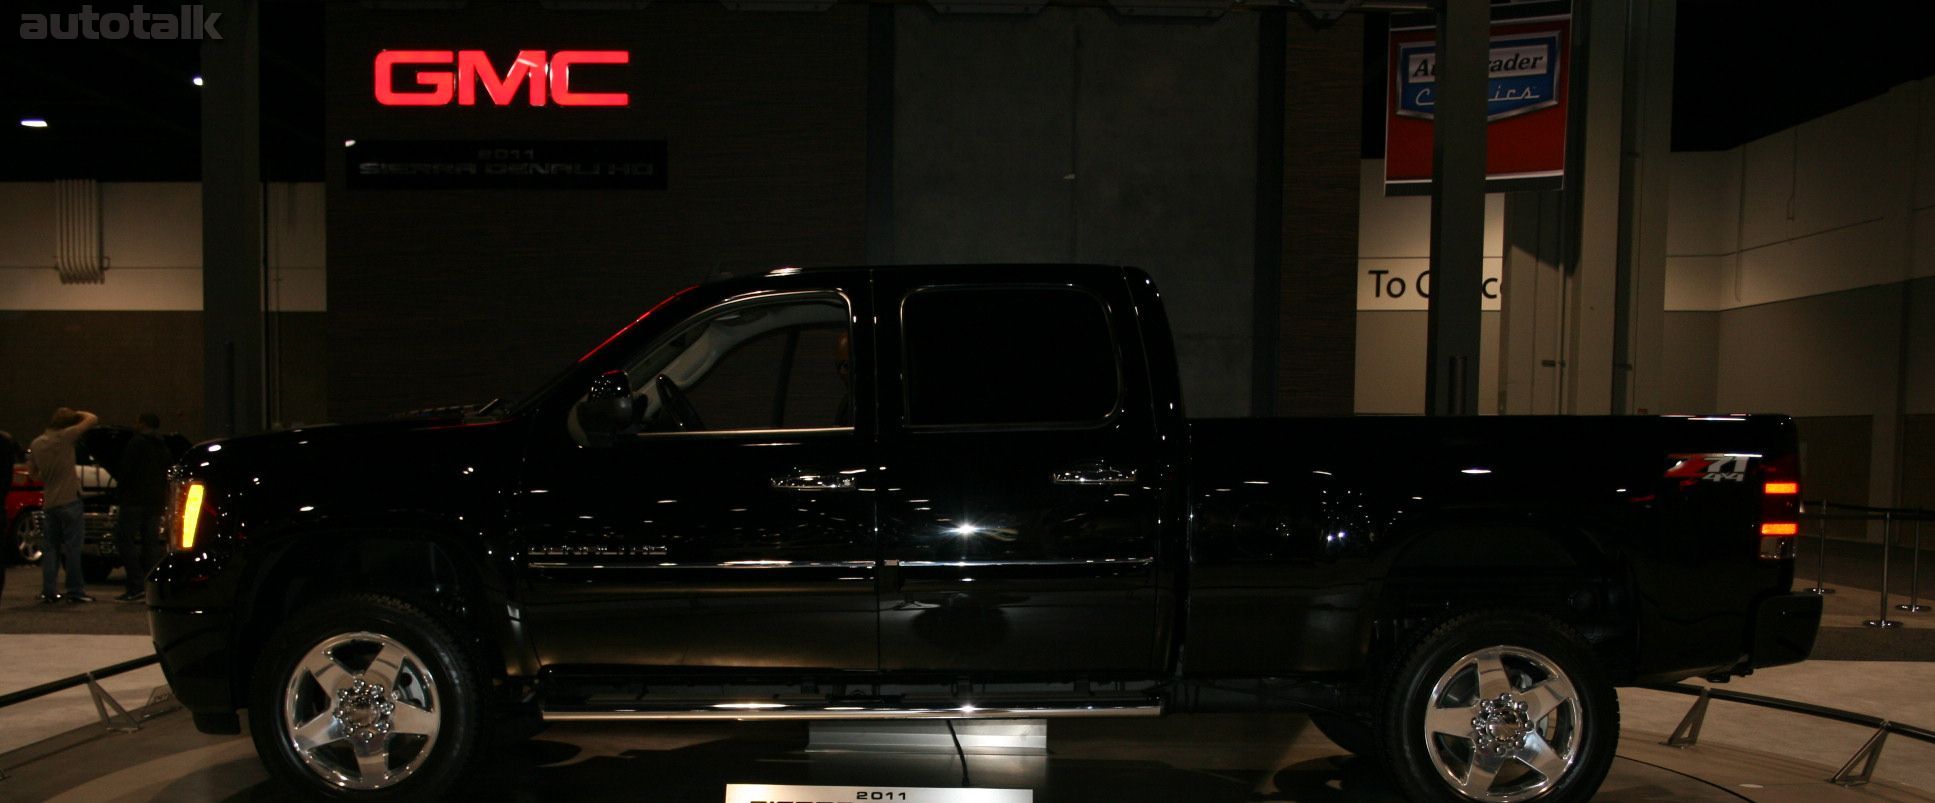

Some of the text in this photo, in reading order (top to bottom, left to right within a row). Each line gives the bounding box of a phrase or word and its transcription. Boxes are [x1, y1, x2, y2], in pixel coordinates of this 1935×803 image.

[373, 49, 631, 107] GMC
[1368, 270, 1405, 298] To
[856, 791, 907, 800] 2011
